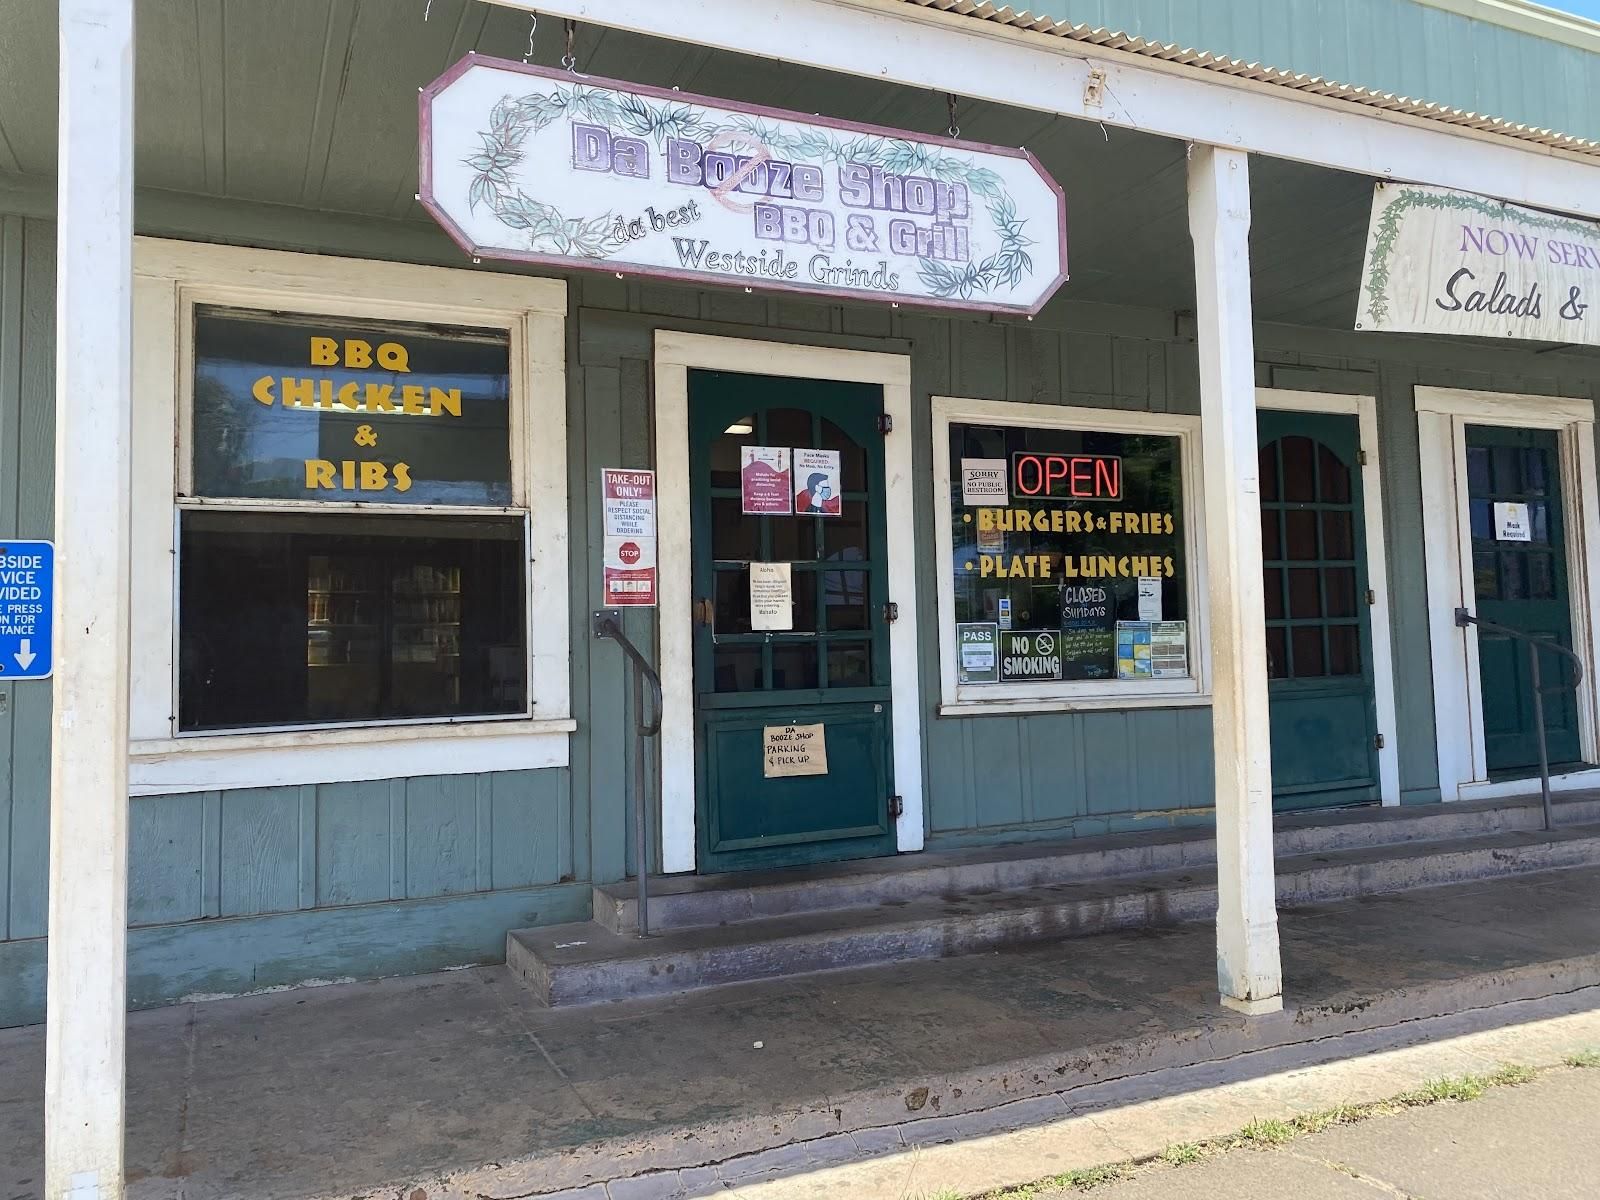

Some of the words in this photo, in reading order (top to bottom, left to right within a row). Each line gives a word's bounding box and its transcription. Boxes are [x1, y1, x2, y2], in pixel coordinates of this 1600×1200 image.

[572, 121, 649, 179] Da
[666, 136, 824, 201] Booze
[839, 161, 969, 223] Shop
[614, 214, 646, 243] da
[645, 199, 701, 233] best
[754, 202, 835, 252] BBQ
[846, 213, 879, 252] &
[890, 219, 969, 262] Grill
[1460, 225, 1538, 261] NOW
[672, 237, 798, 279] Westside
[808, 253, 899, 290] Grinds
[1435, 267, 1541, 320] Salads
[1559, 285, 1589, 321] &
[310, 336, 412, 373] BBQ
[252, 375, 462, 417] CHICKEN
[353, 424, 378, 447] &
[304, 459, 412, 492] RIBS
[607, 474, 651, 485] TAKE-OUT
[1018, 456, 1118, 497] OPEN
[616, 487, 642, 497] ONLY!
[980, 555, 1051, 578] PLATE
[1065, 555, 1175, 578] LUNCHES
[1066, 587, 1106, 604] CLOSED
[7, 604, 43, 614] PRESS
[14, 615, 35, 624] FOR
[0, 625, 35, 635] TANCE
[963, 631, 992, 641] PASS
[1011, 636, 1029, 654] NO
[1003, 656, 1059, 675] SMOKING
[770, 734, 793, 742] BOOZE
[767, 744, 806, 754] PARKING
[778, 757, 795, 765] PICK
[798, 755, 809, 763] UP
